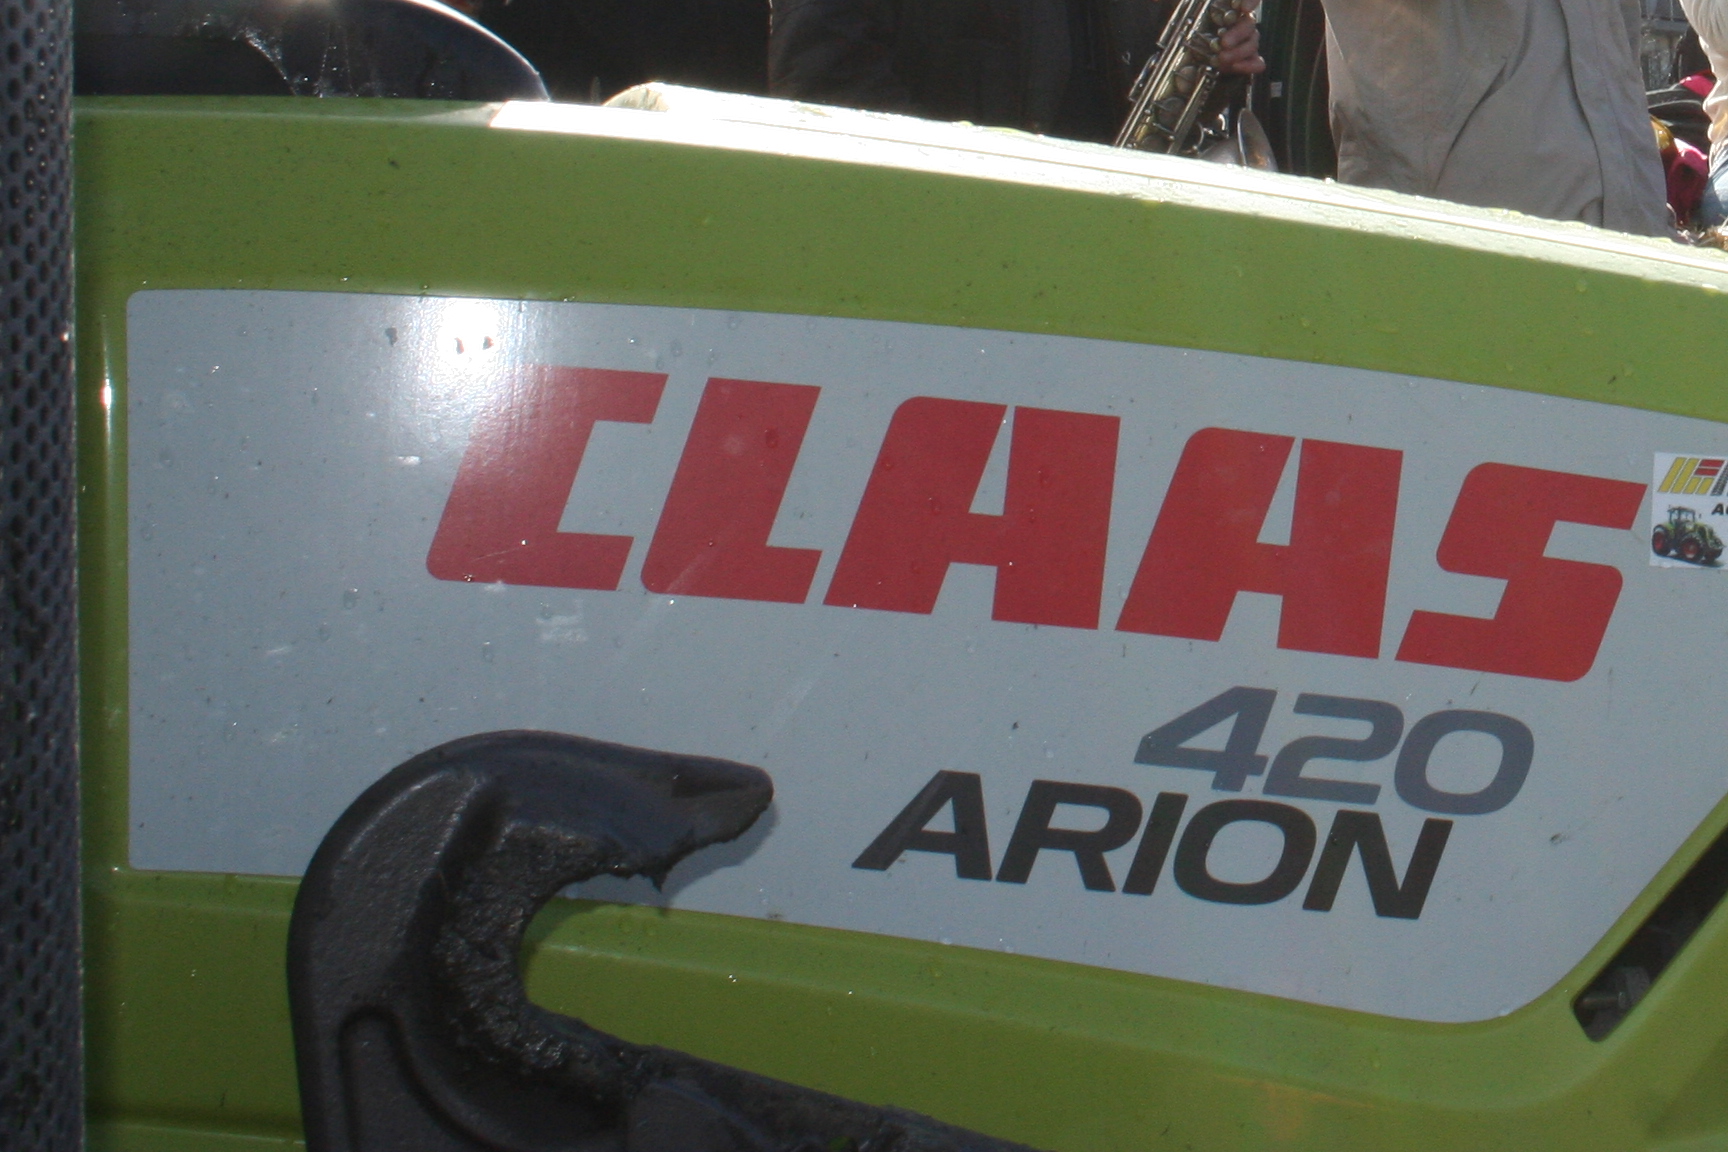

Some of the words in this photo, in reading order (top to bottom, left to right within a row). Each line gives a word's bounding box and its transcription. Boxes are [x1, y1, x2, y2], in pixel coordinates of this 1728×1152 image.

[426, 363, 1648, 683] CLAAS
[1134, 685, 1535, 816] 420
[851, 769, 1454, 921] ARION
